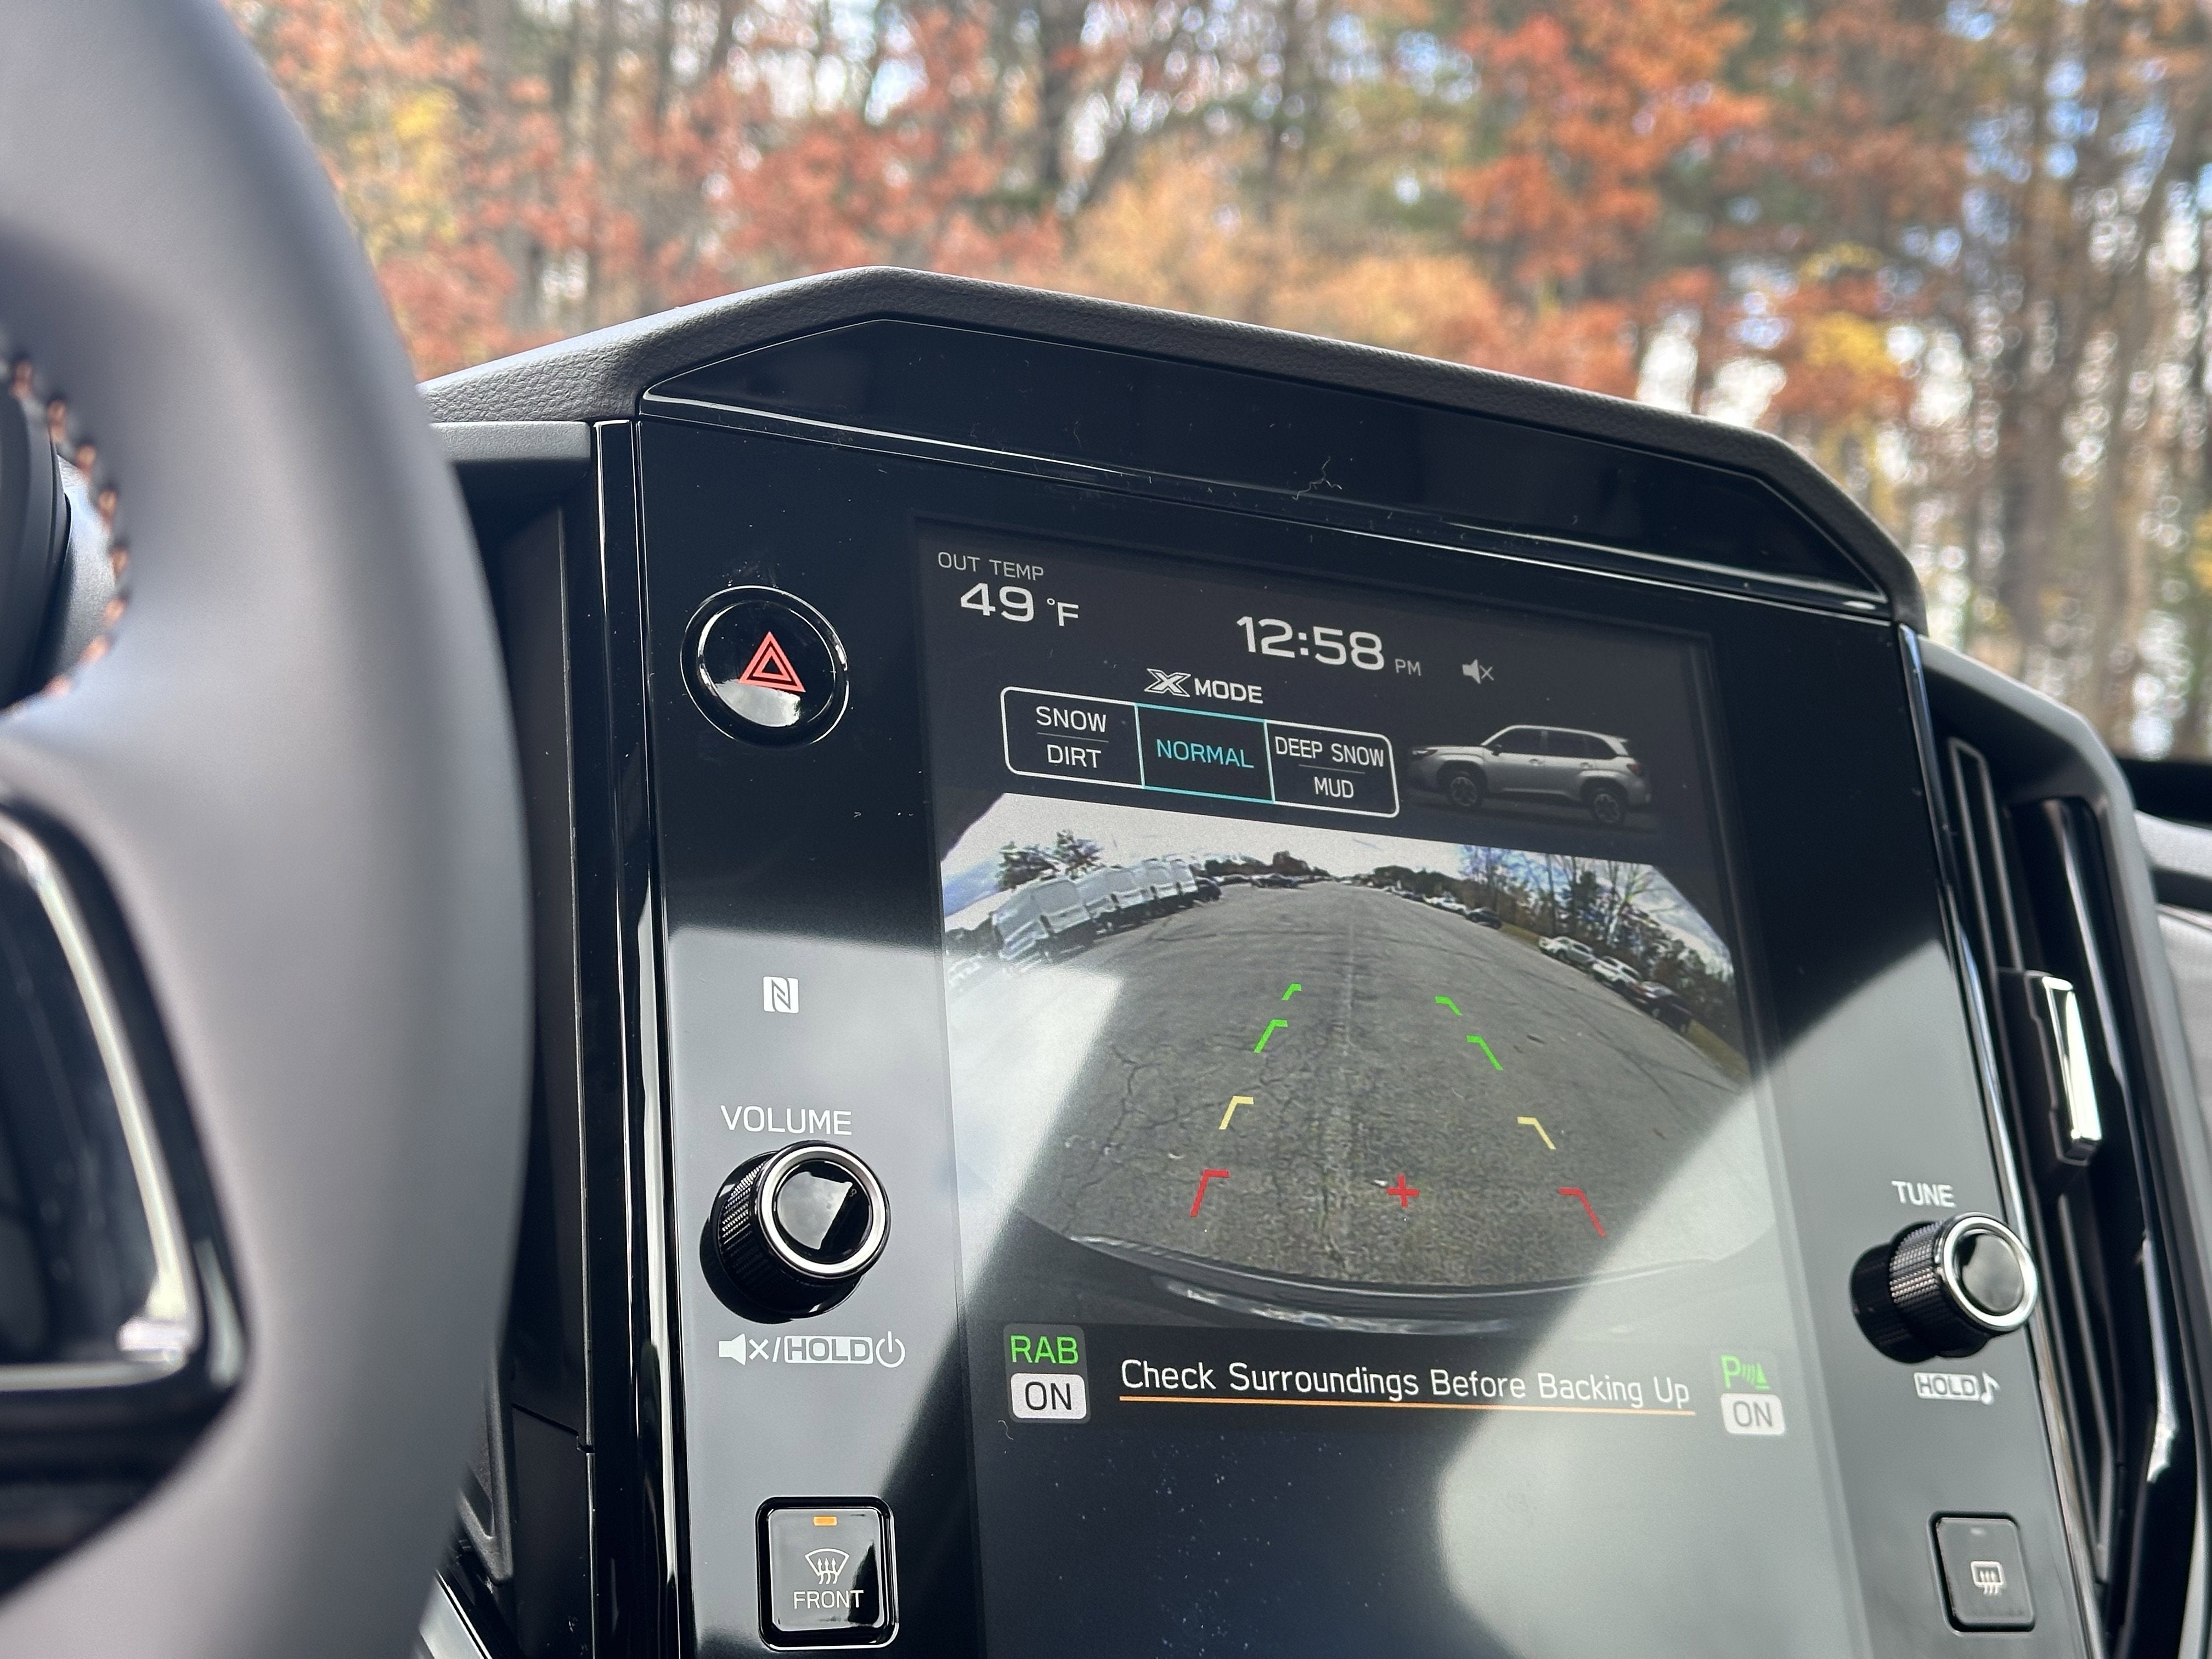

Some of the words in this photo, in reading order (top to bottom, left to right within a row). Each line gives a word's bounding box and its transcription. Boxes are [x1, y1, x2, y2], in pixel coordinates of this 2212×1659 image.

[938, 551, 980, 572] OUT
[989, 560, 1043, 580] TEMP
[961, 583, 1034, 622] 49
[1237, 616, 1385, 670] 12:58
[1395, 659, 1421, 676] PM
[1194, 678, 1263, 704] MODE
[1036, 706, 1106, 732] SNOW
[1047, 744, 1101, 769] DIRT
[1156, 739, 1254, 769] NORMAL
[1275, 736, 1323, 759] DEEP
[1331, 744, 1384, 768] SNOW
[1314, 777, 1354, 799] MUD
[721, 1105, 852, 1136] VOLUME
[1892, 1180, 1956, 1207] TUNE
[1010, 1335, 1079, 1364] RAB
[1025, 1381, 1073, 1410] ON
[1121, 1359, 1216, 1390] Check
[1229, 1362, 1420, 1401] Surroundings
[1430, 1369, 1526, 1398] Before
[1538, 1373, 1644, 1407] Backing
[1654, 1376, 1690, 1408] Up
[1917, 1374, 1976, 1397] HOLD
[1733, 1401, 1773, 1427] ON
[793, 1589, 864, 1609] FRONT
